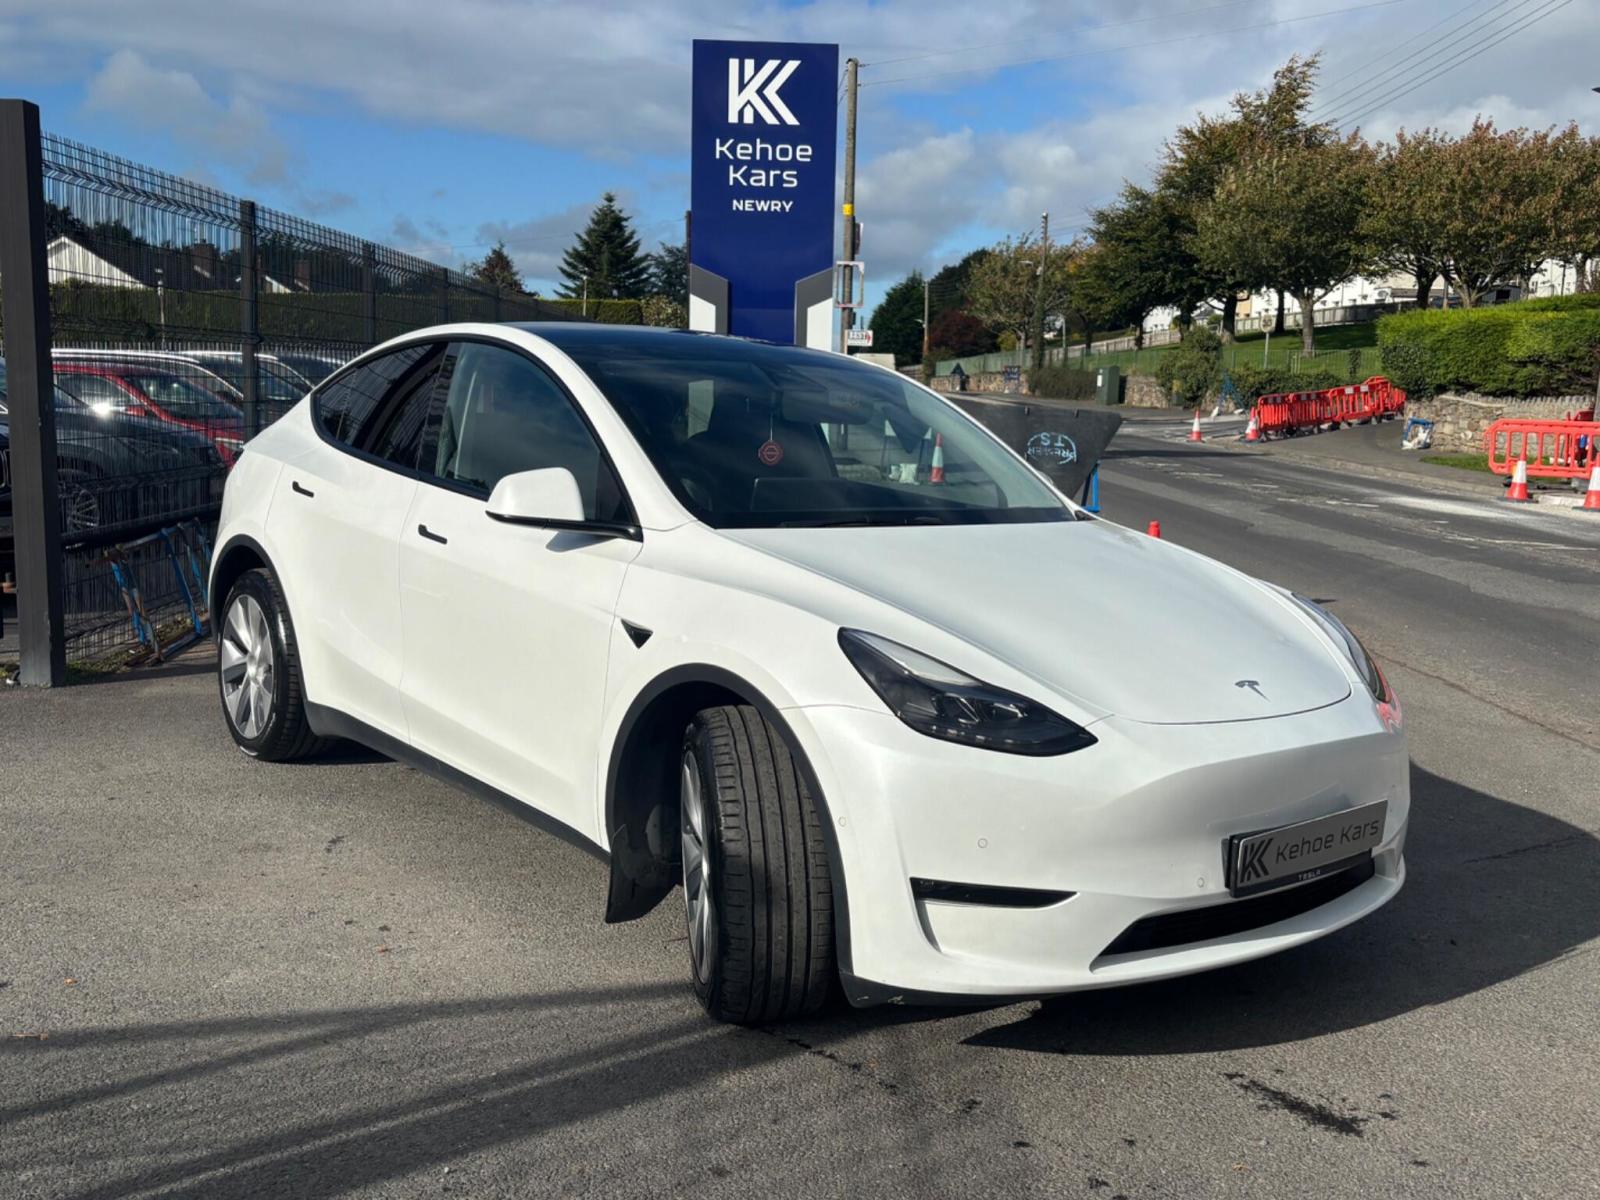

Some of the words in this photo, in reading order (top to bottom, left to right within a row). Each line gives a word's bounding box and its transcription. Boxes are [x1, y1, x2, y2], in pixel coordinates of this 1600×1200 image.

[715, 138, 812, 162] Kehoe
[728, 165, 798, 188] Kars
[732, 199, 793, 213] NEWRY
[1275, 836, 1334, 864] Kehoe
[1340, 819, 1379, 845] Kars
